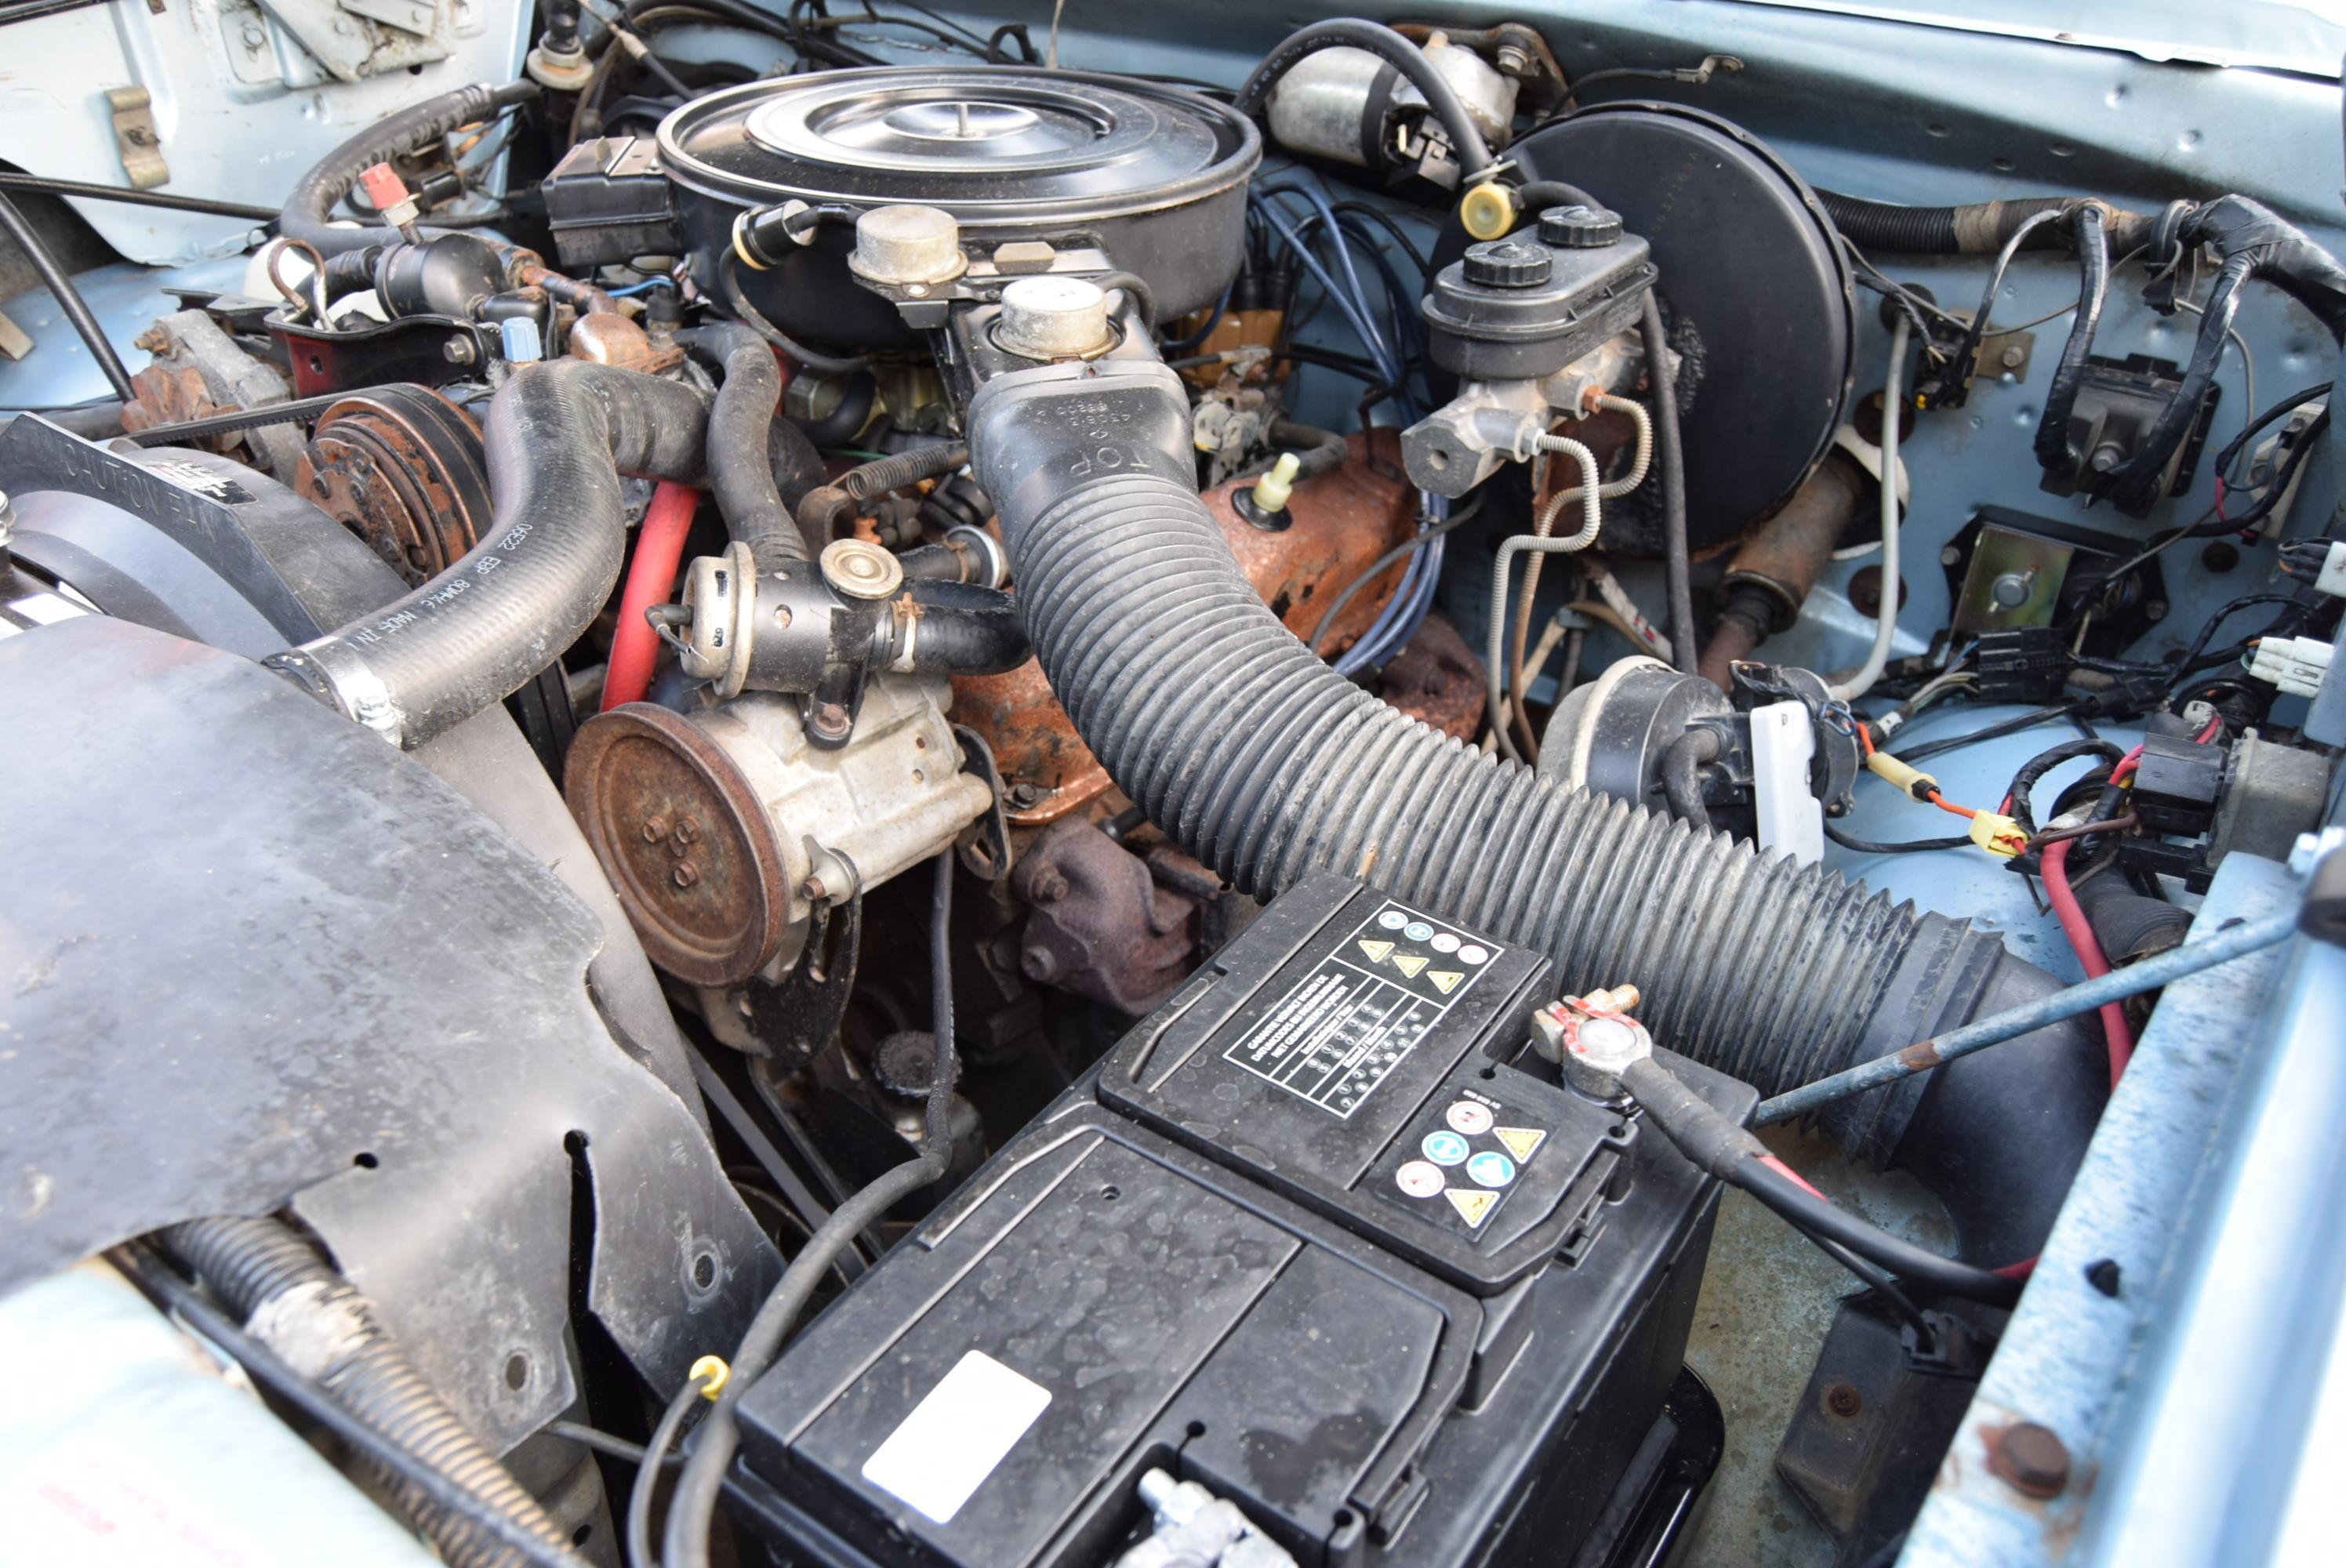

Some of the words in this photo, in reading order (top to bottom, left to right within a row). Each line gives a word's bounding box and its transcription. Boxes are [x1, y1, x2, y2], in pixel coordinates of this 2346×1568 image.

[1070, 445, 1152, 477] TOP
[65, 444, 159, 515] CAUTION
[475, 556, 501, 575] EBP
[379, 611, 418, 633] MADE
[356, 628, 383, 645] IN
[1315, 975, 1329, 984] DE
